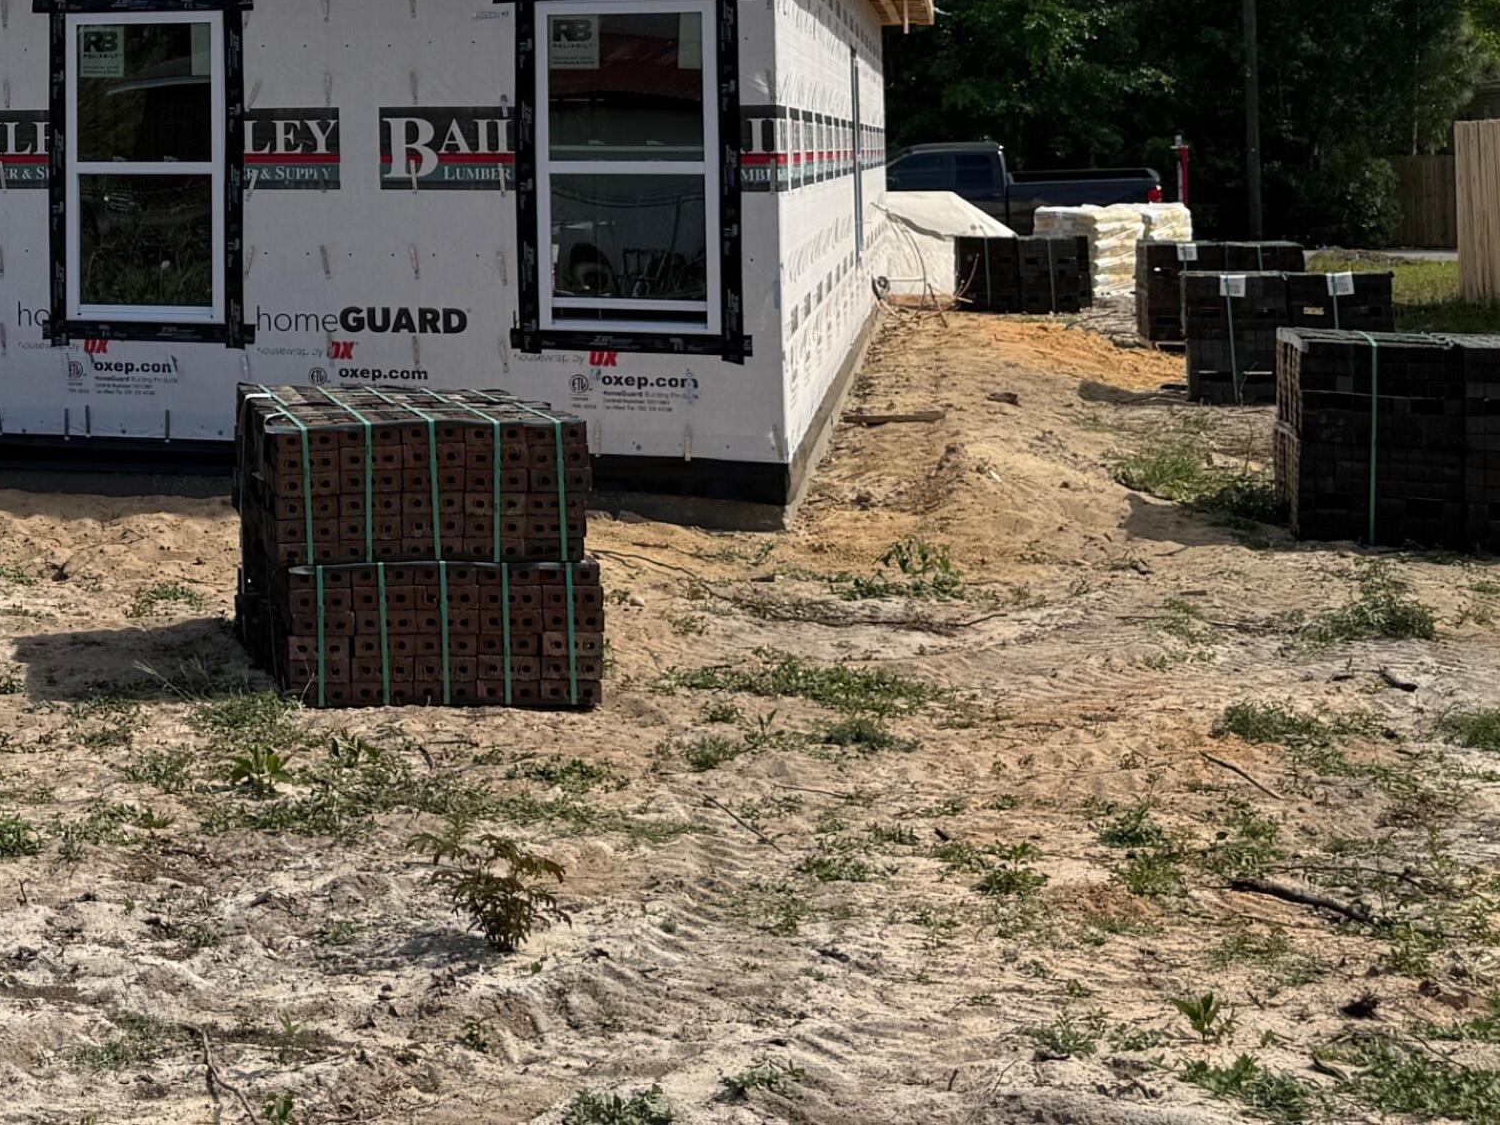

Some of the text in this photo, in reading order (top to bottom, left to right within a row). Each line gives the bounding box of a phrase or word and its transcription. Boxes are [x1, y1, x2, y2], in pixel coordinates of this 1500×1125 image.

[553, 19, 593, 42] RB
[244, 119, 338, 154] LEY
[257, 306, 467, 335] homeGUARD
[338, 366, 428, 381] oxep.com
